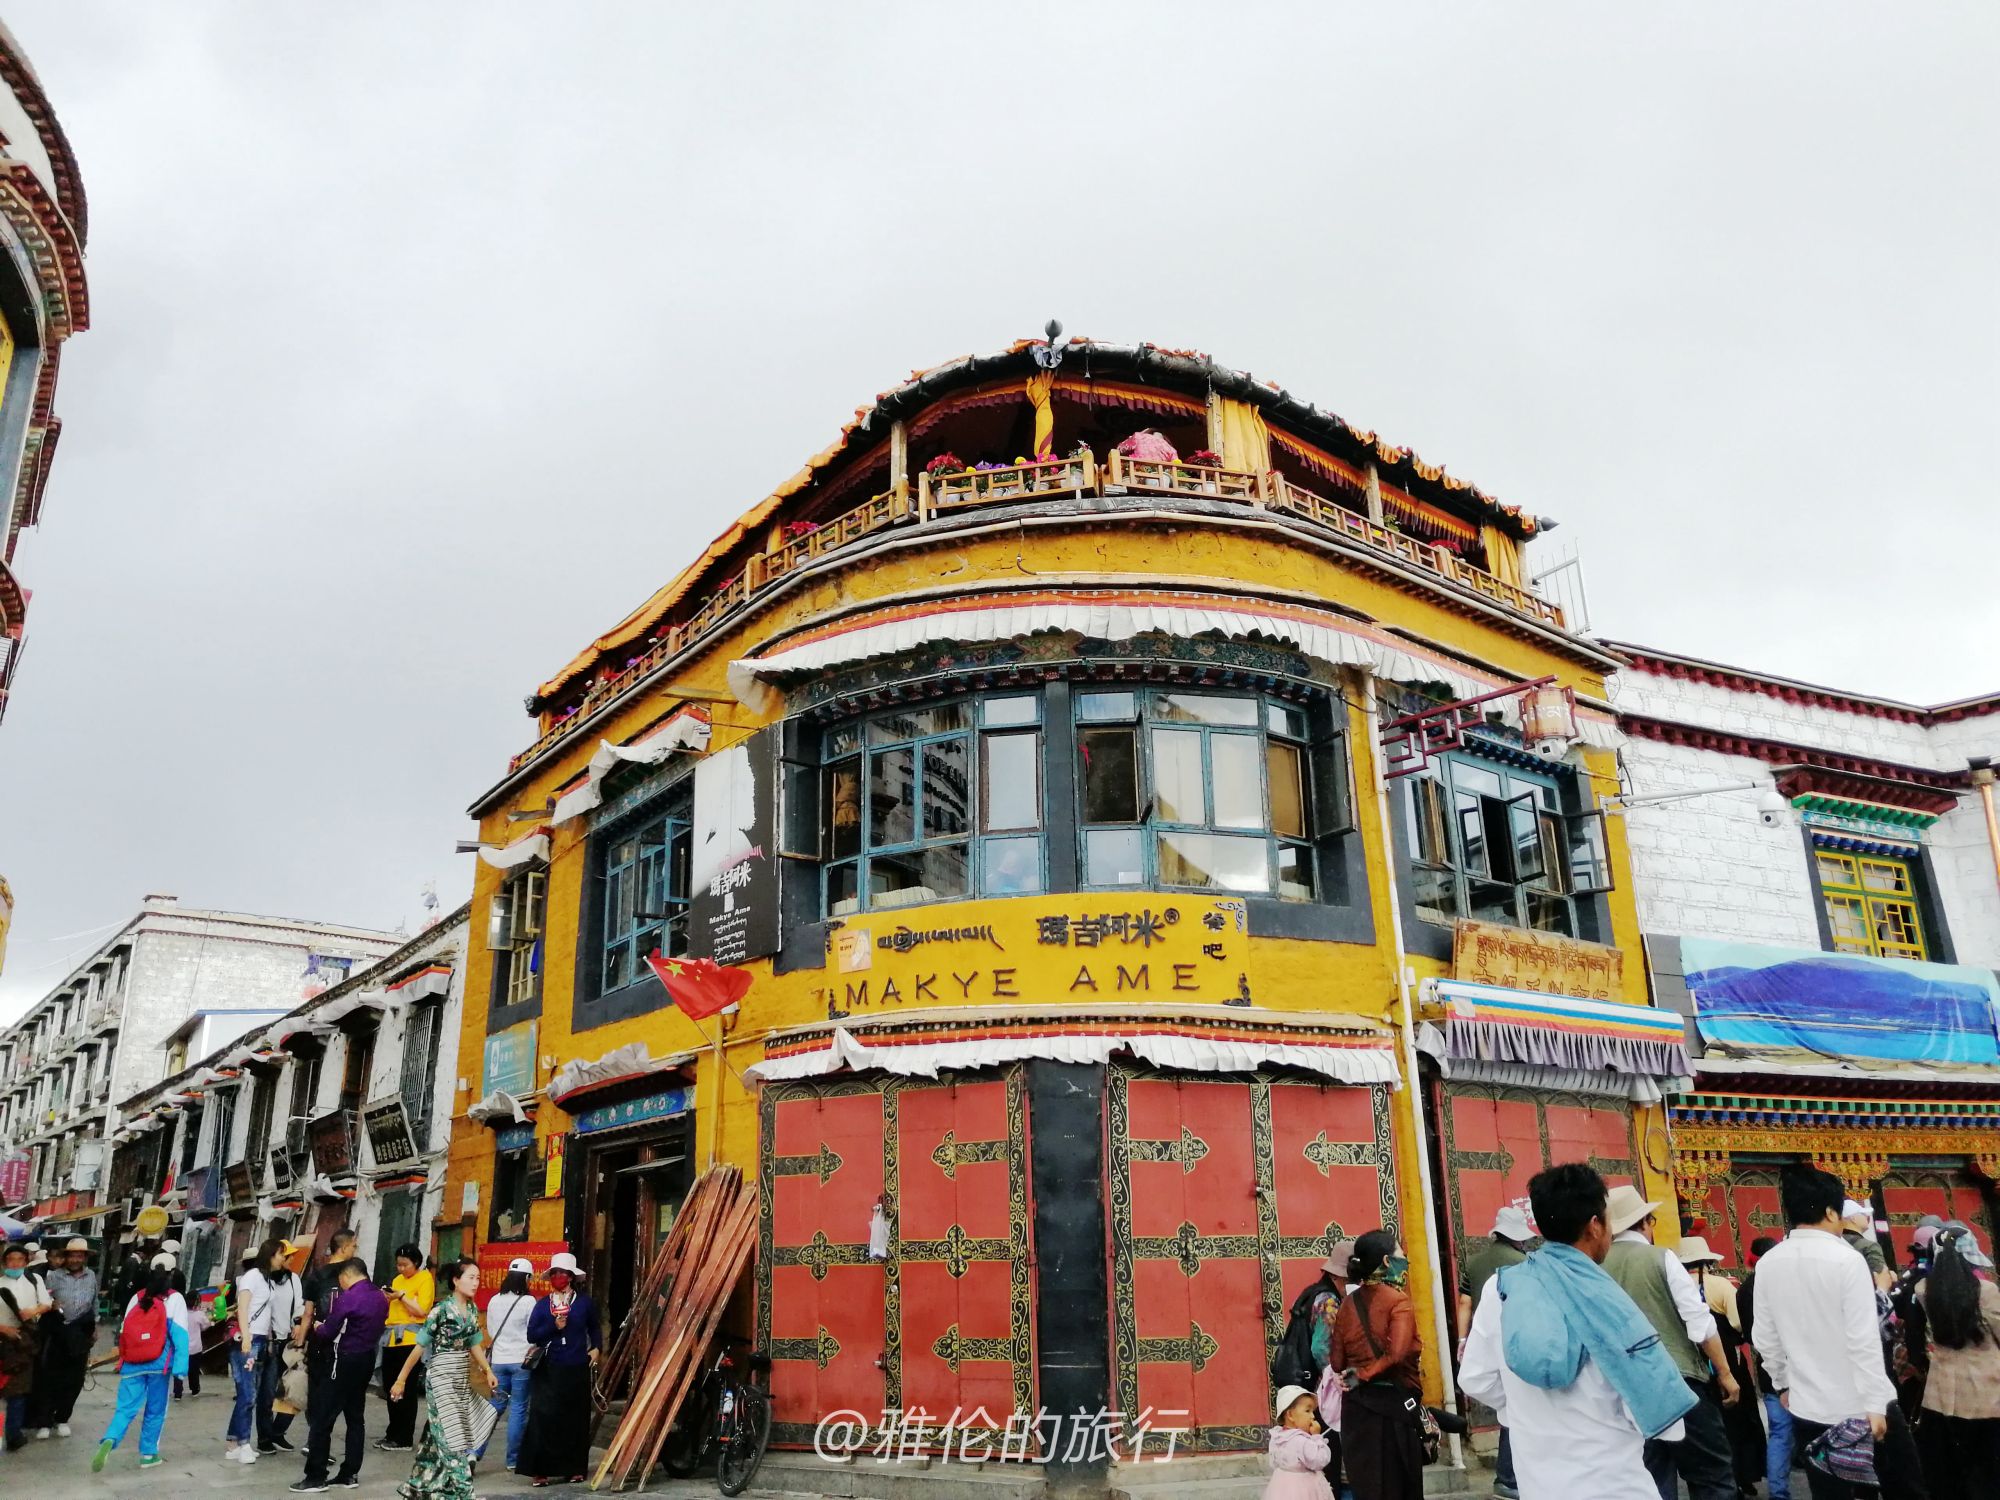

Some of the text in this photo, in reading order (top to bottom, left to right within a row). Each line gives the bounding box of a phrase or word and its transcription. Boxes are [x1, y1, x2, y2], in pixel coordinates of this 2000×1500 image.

[709, 912, 732, 925] Makye
[845, 964, 1201, 1009] MAKYE AME
